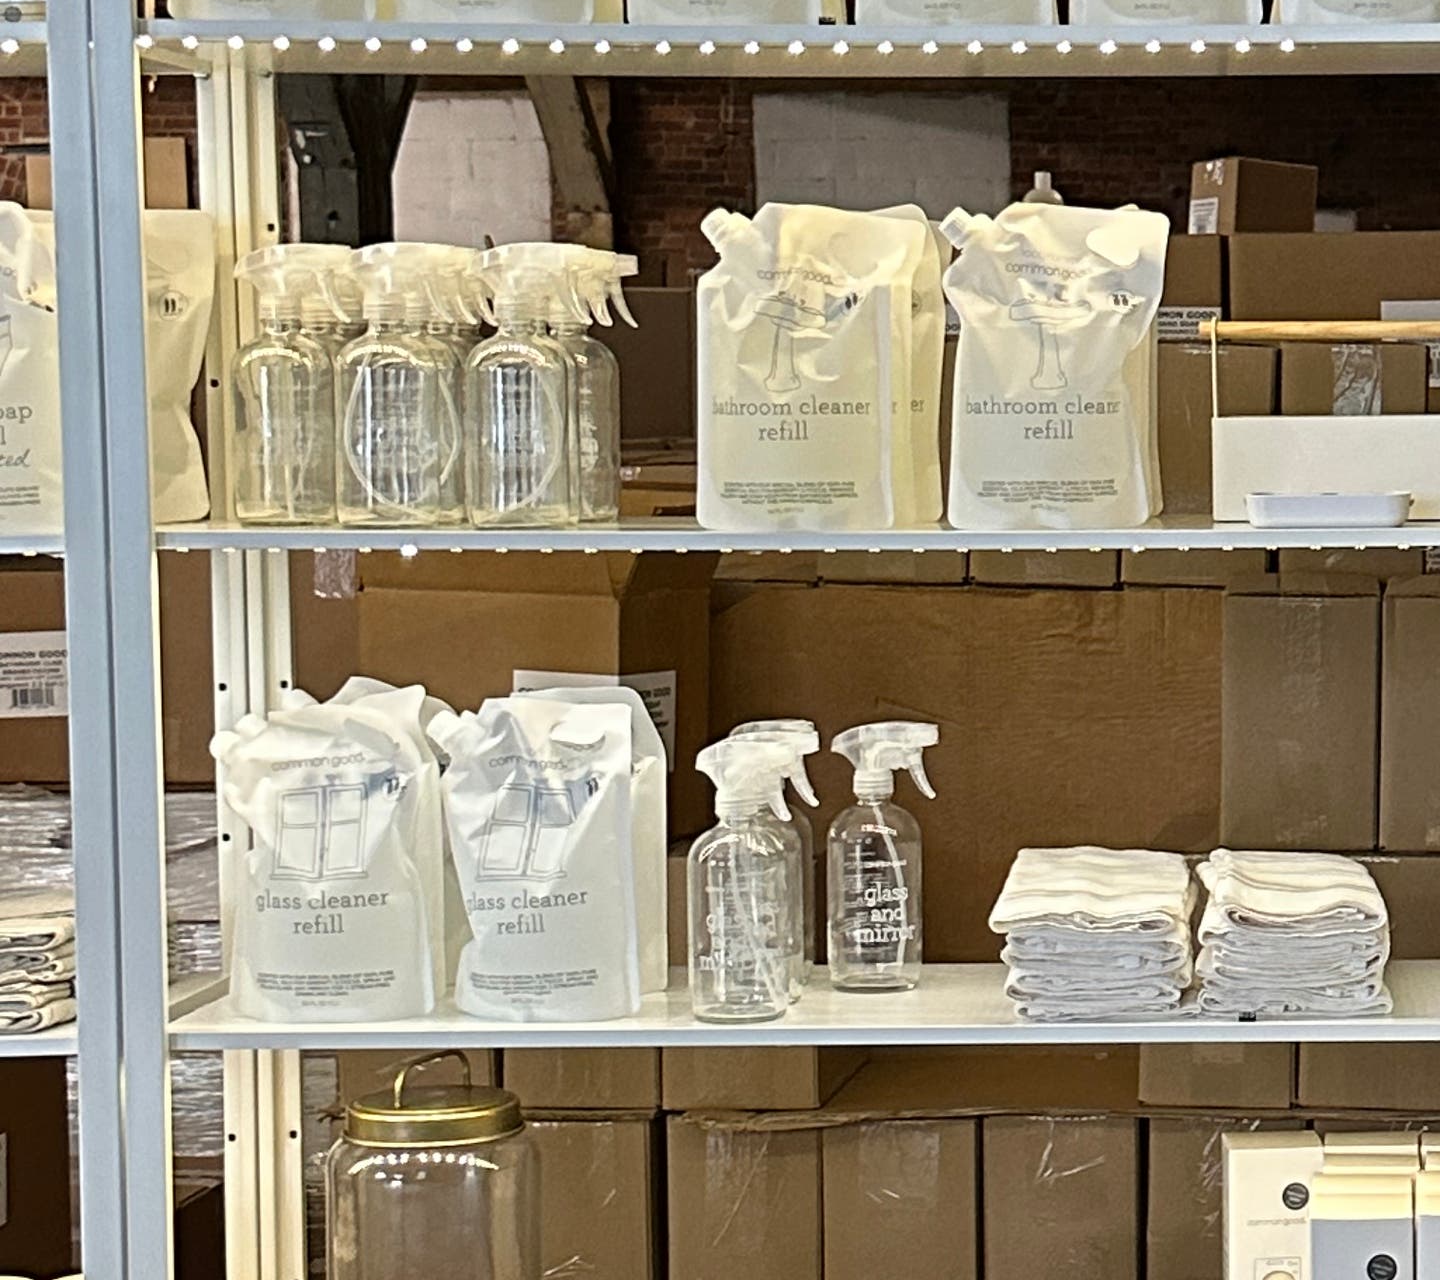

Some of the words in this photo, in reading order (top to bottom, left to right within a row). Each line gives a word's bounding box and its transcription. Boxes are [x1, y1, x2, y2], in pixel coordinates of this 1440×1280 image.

[0, 405, 33, 424] oap
[799, 393, 870, 416] cleaner
[966, 394, 1058, 415] bathroom
[757, 420, 810, 441] refill
[1023, 419, 1074, 440] refill
[255, 889, 301, 913] glass
[308, 889, 390, 910] cleaner
[511, 889, 588, 910] cleaner
[864, 881, 909, 908] glass
[293, 913, 345, 935] refill
[497, 913, 546, 936] refill
[870, 907, 905, 923] and
[854, 923, 916, 944] mirror
